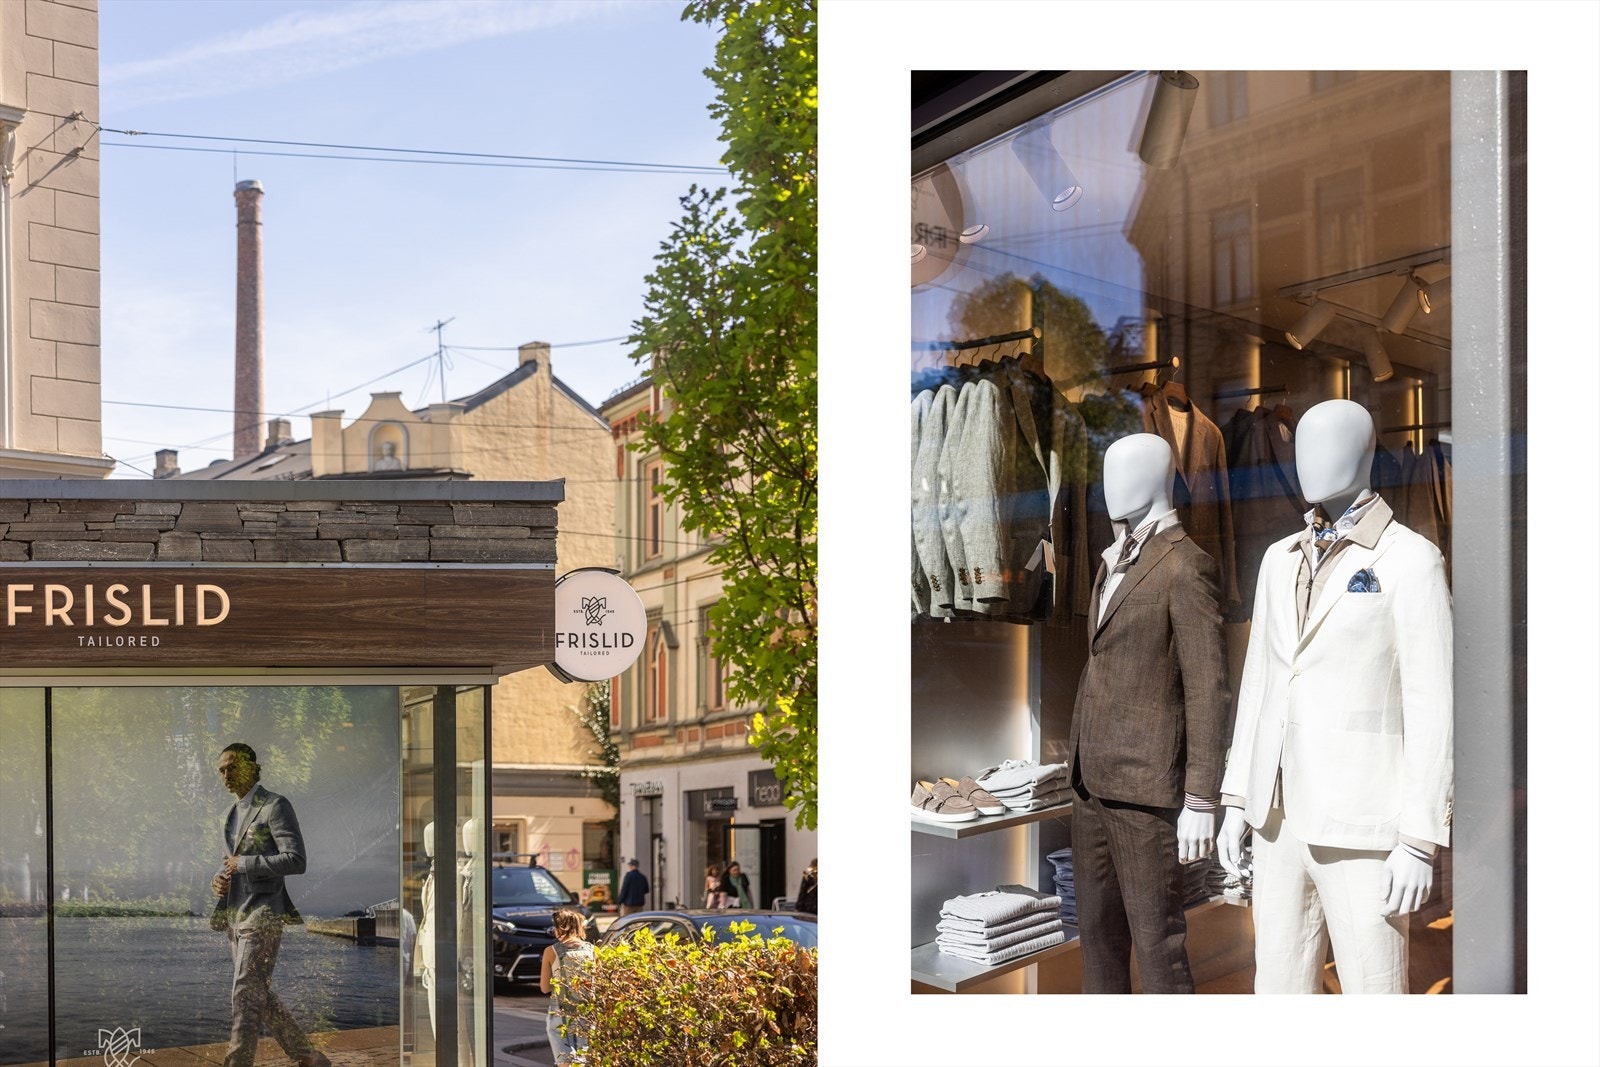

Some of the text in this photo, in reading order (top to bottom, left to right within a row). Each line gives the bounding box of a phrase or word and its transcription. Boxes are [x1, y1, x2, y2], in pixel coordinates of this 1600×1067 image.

[7, 583, 231, 626] FRISLID
[78, 636, 160, 647] TAILORED
[555, 632, 634, 648] FRISLID
